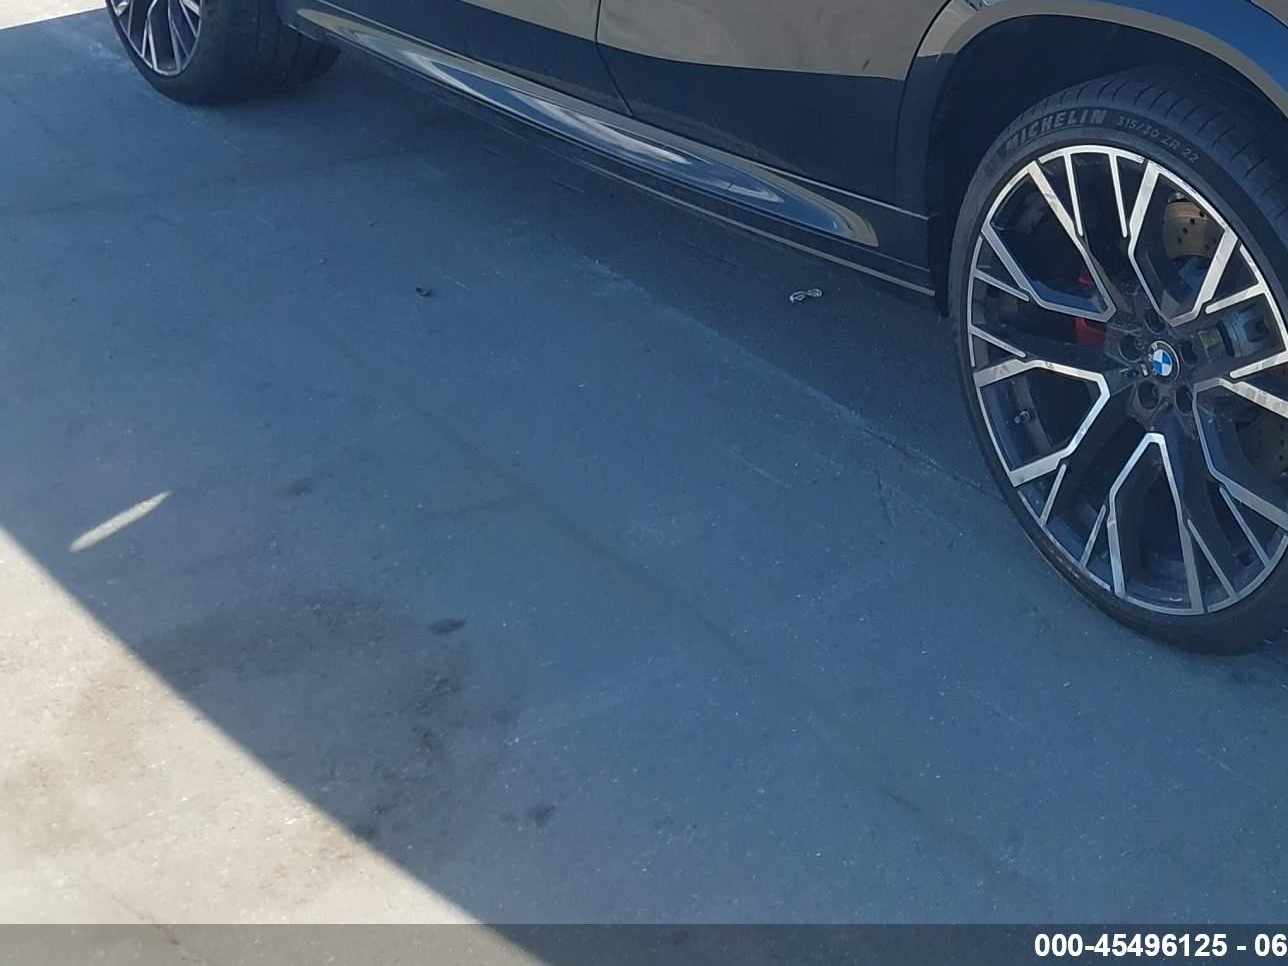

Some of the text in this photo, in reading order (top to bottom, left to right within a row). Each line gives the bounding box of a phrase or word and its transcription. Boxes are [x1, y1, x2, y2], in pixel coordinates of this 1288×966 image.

[1006, 109, 1199, 163] MICHELIN 315/30 ZR 22
